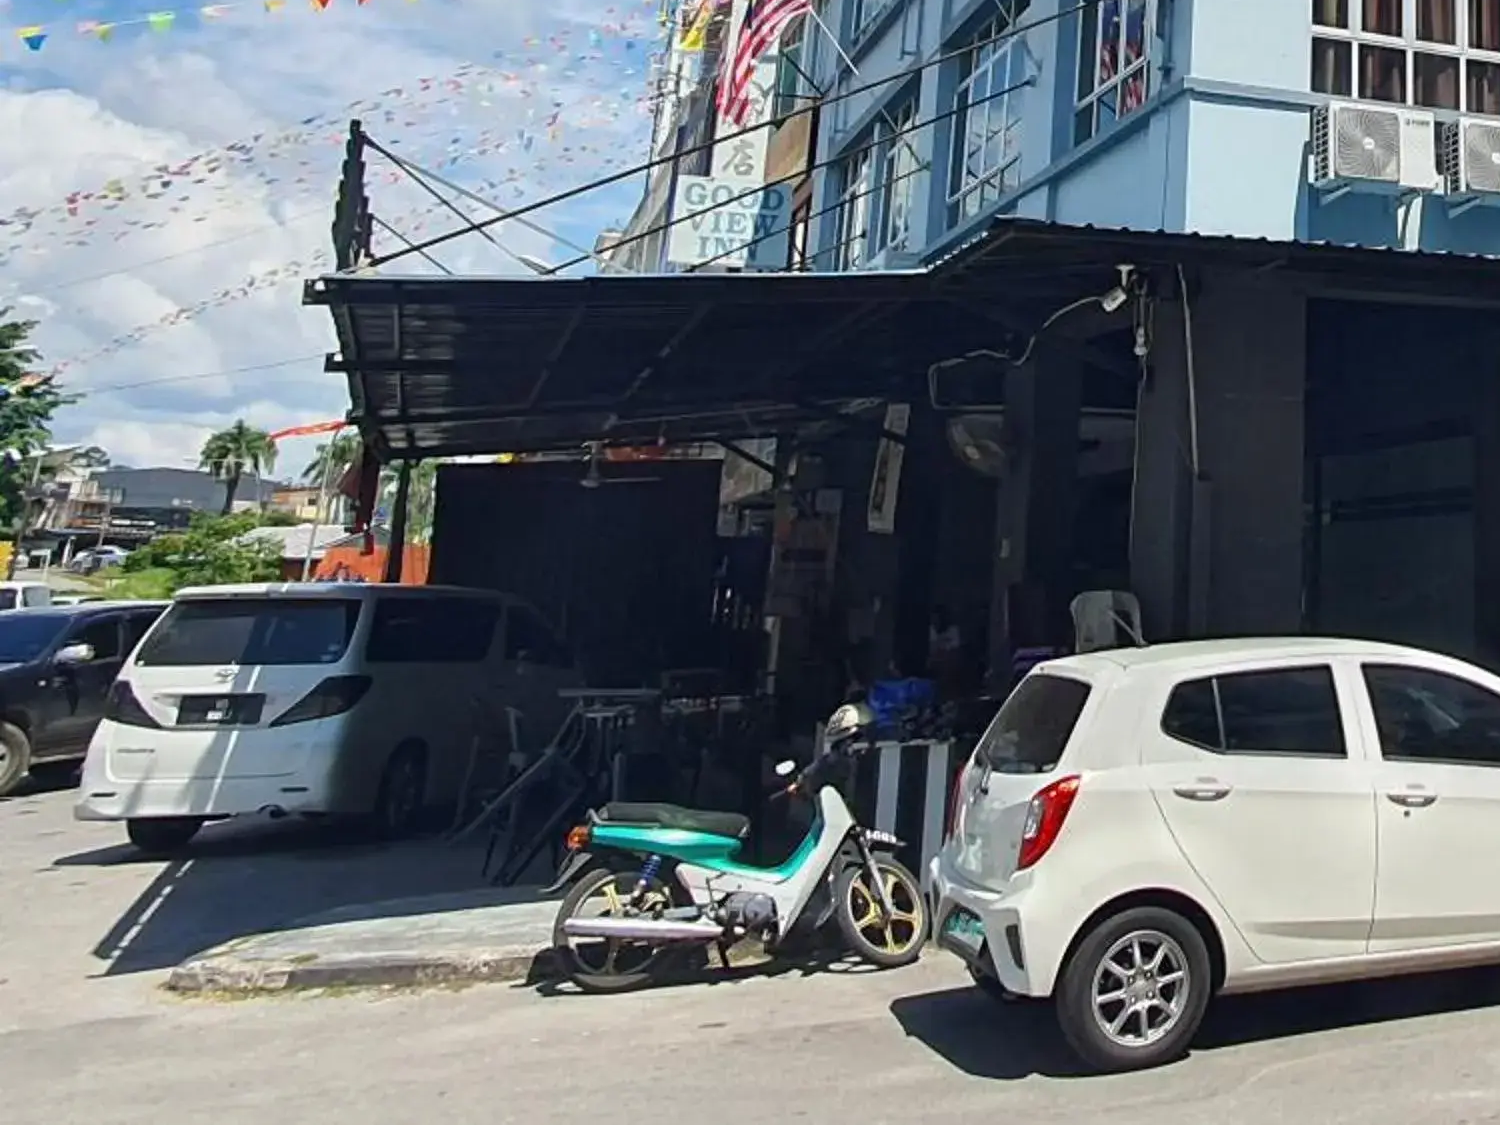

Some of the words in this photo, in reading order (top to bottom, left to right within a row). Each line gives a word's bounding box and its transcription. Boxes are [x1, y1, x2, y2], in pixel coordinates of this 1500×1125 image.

[722, 139, 755, 175] 店
[685, 182, 784, 211] GOOD
[687, 209, 778, 236] VIEW
[699, 236, 761, 261] INN
